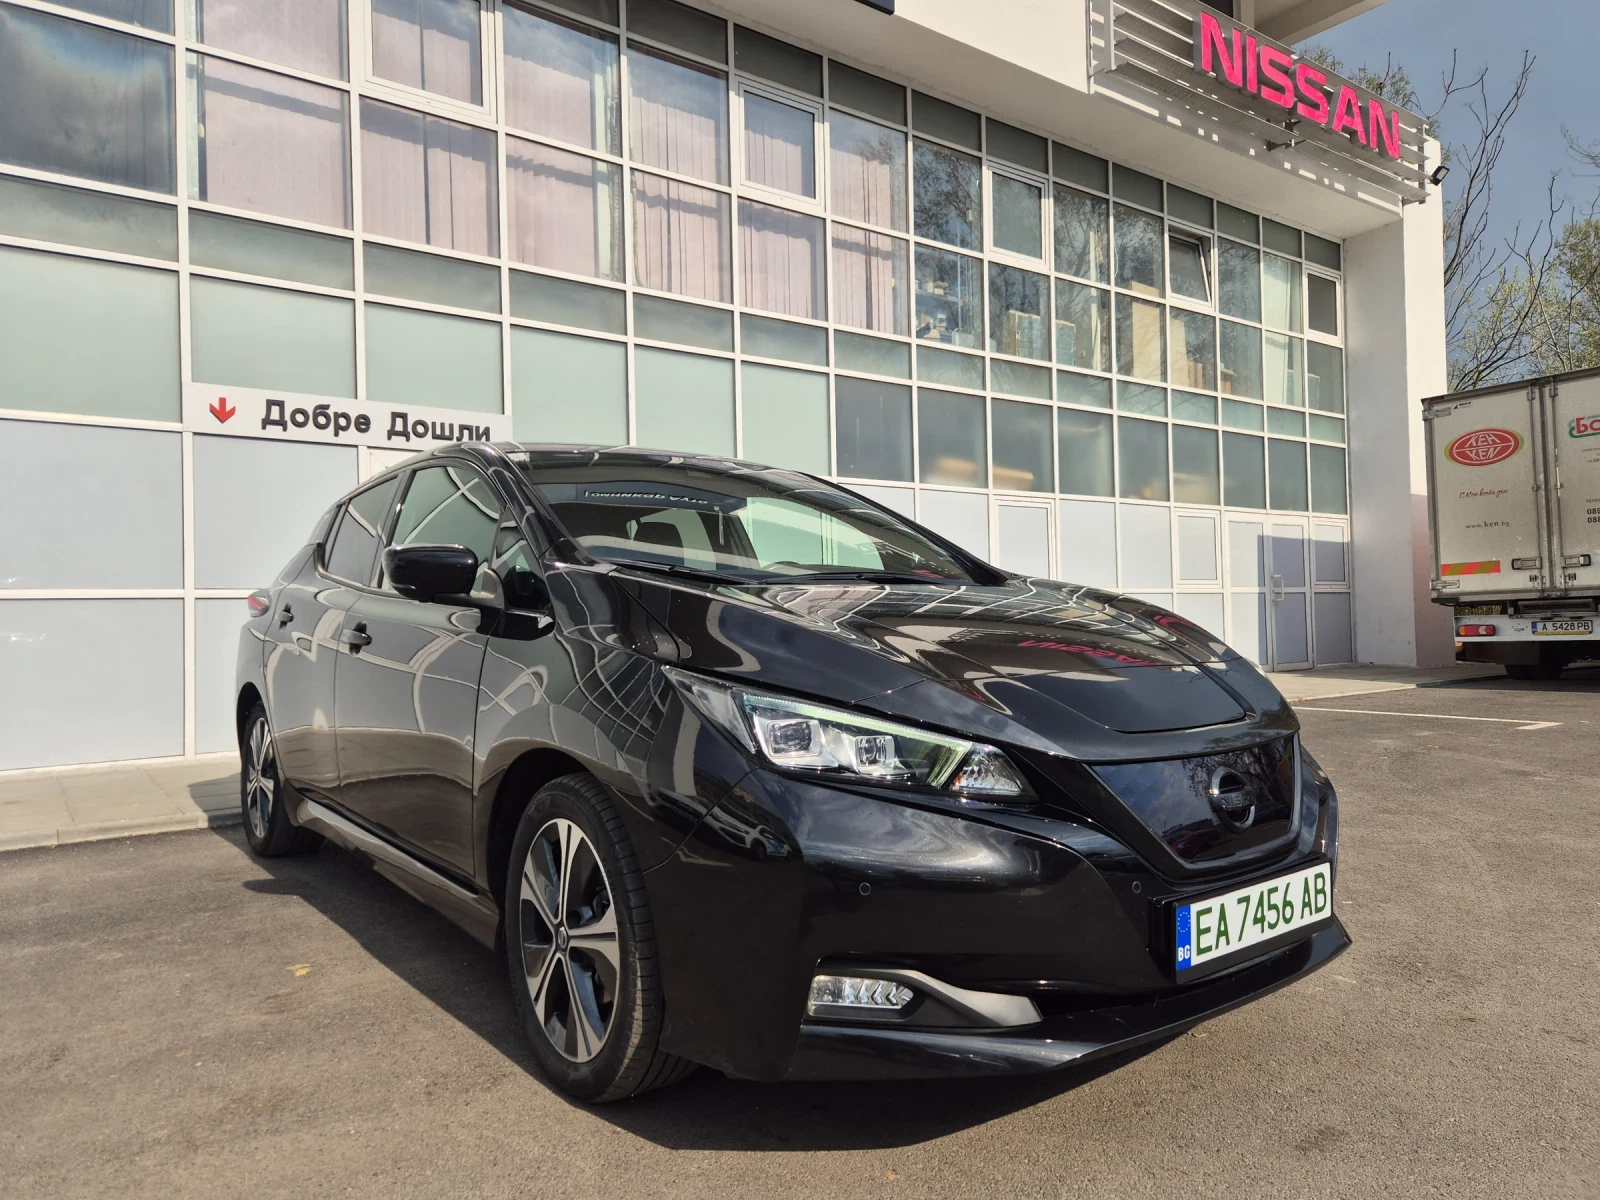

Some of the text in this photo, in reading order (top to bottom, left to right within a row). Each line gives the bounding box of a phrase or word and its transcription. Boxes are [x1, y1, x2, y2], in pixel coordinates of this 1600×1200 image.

[1201, 10, 1400, 160] NISSAN
[261, 398, 491, 442] Добре Дошли
[1465, 446, 1501, 461] KEN
[1552, 622, 1576, 631] 5428
[1576, 621, 1590, 631] PB
[1196, 871, 1327, 957] EA 7456 AB
[1177, 944, 1191, 962] BG
